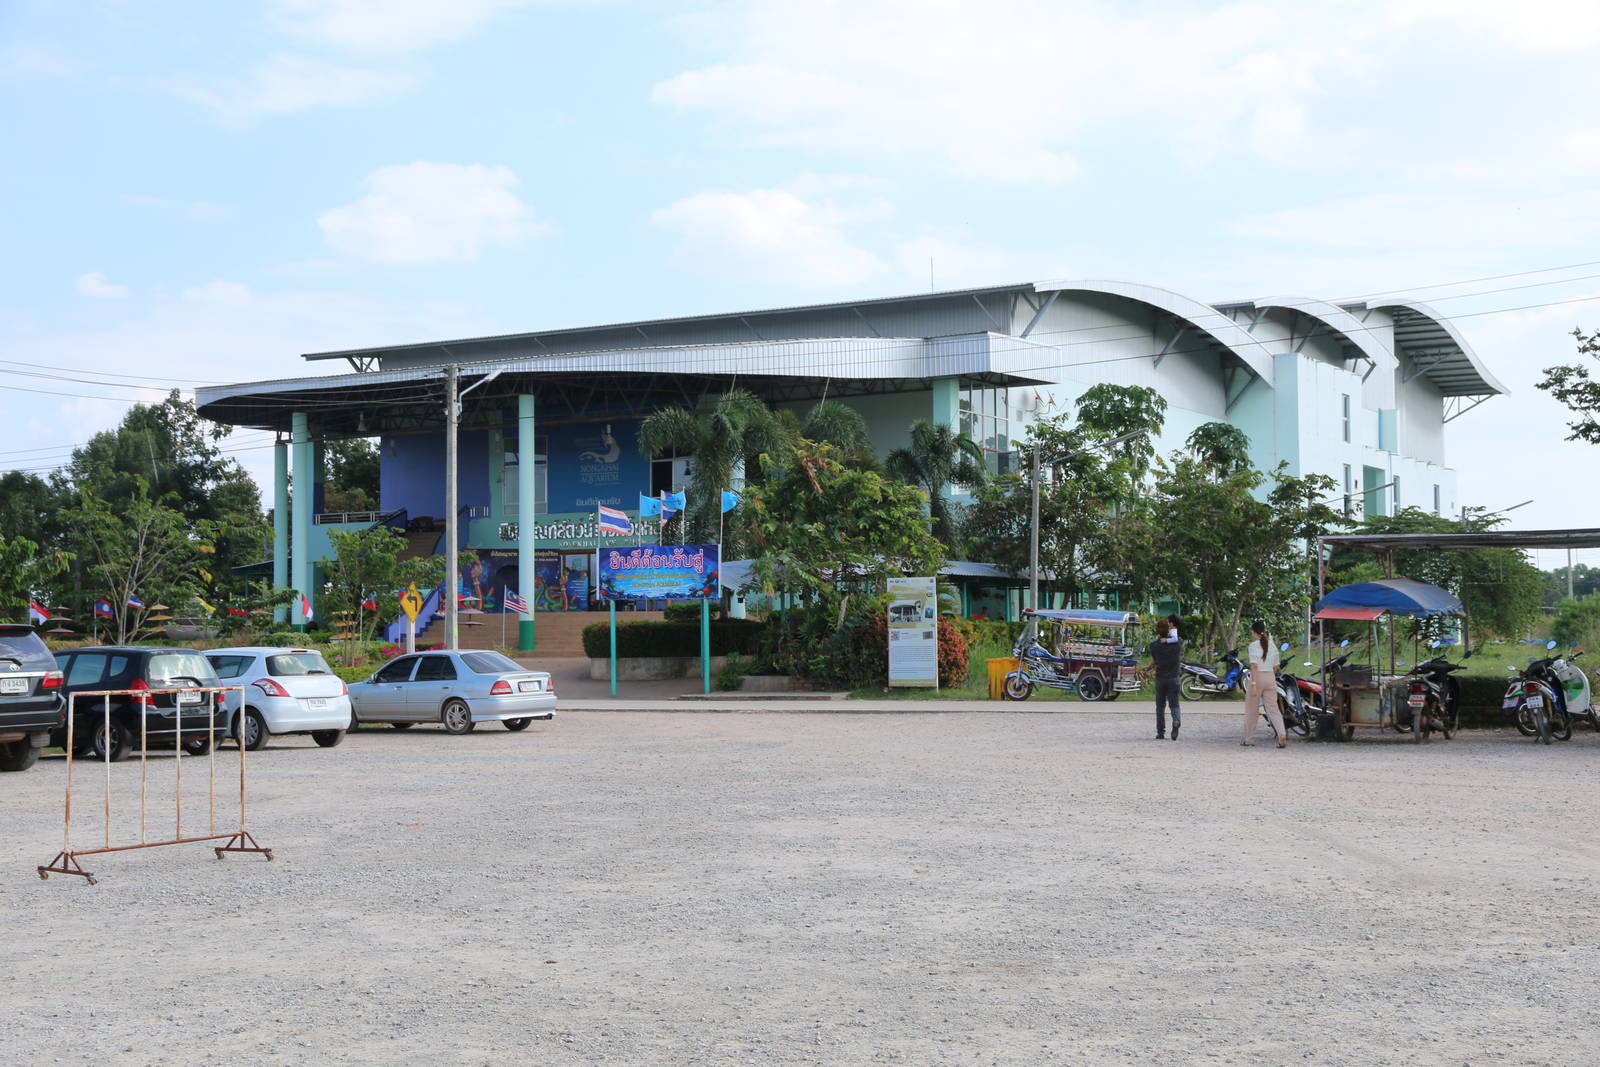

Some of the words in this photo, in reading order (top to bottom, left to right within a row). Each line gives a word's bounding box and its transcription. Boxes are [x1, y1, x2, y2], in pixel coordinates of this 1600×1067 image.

[609, 548, 704, 573] ยินดีต้อนรับสู่
